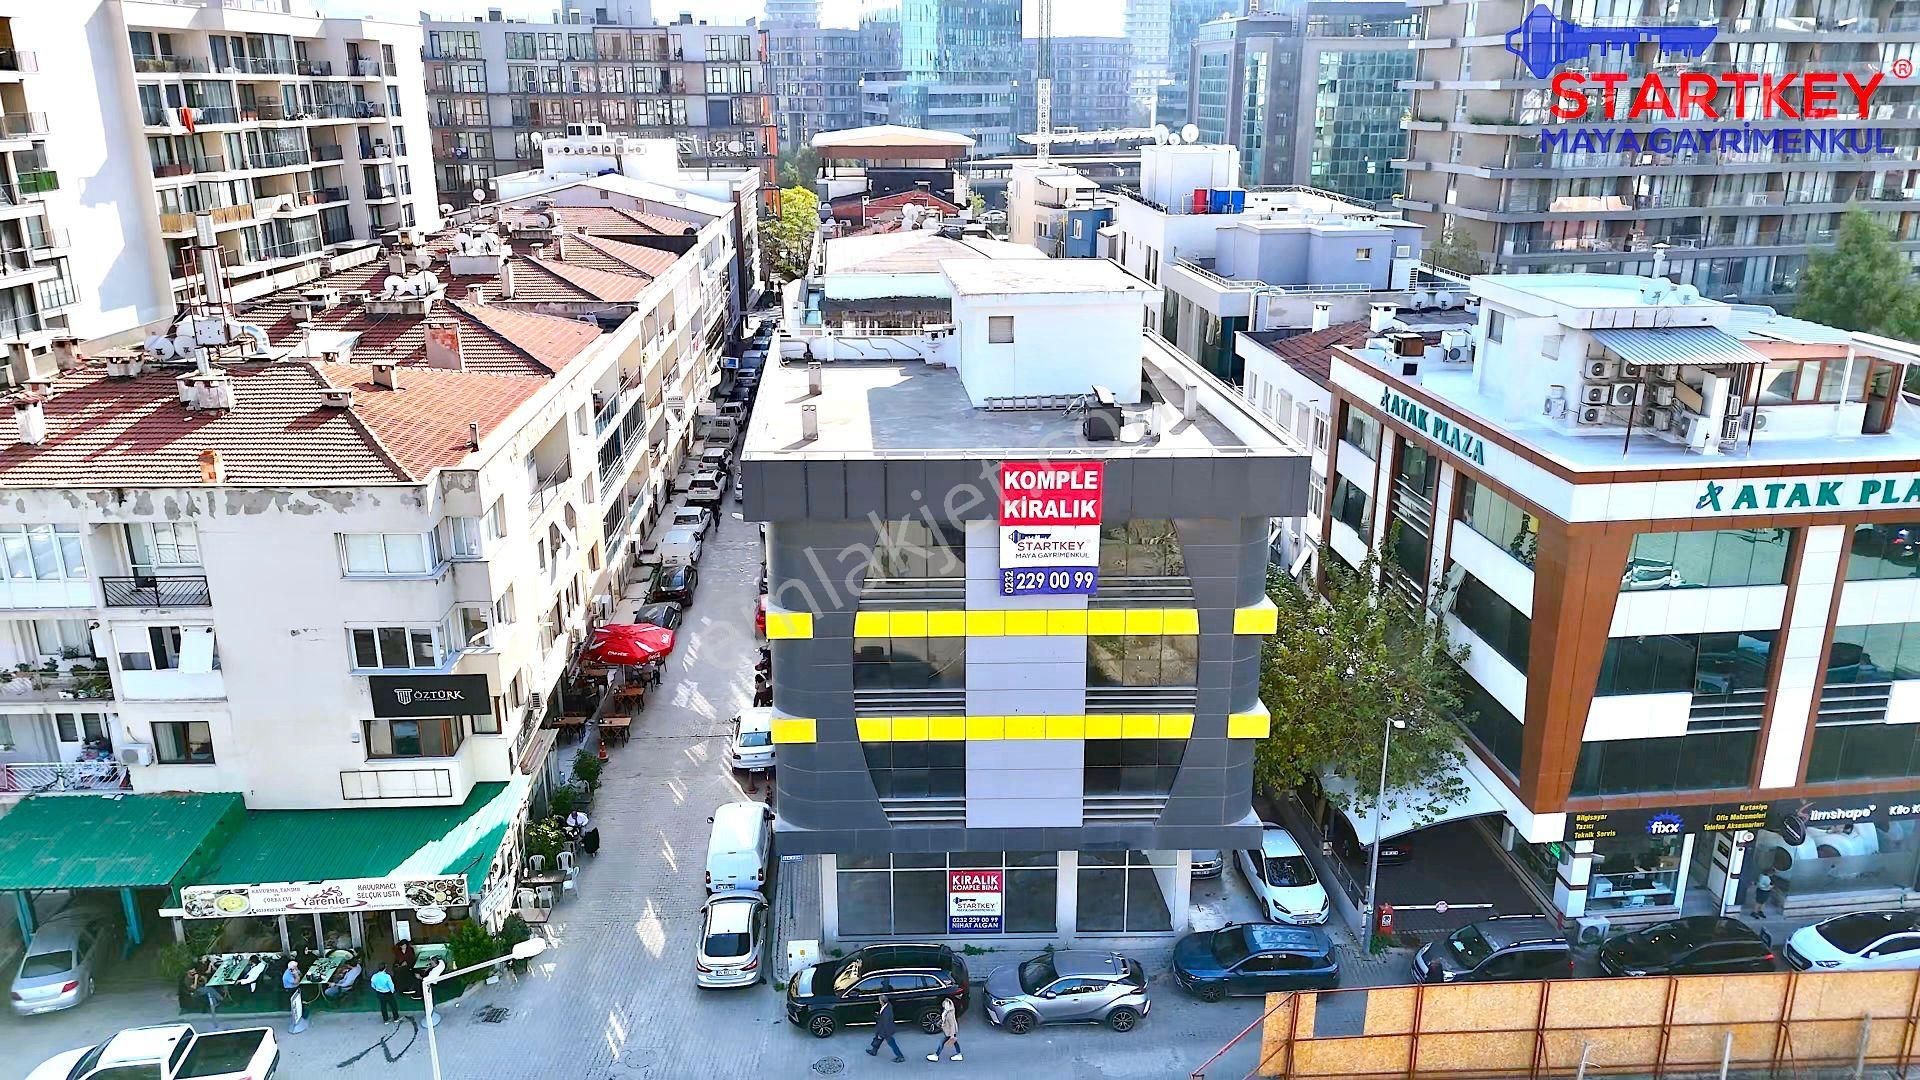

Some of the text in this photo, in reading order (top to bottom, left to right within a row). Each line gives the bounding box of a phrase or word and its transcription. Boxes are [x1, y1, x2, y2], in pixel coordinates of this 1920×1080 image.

[1390, 394, 1484, 466] ATAK PLAZA
[1004, 470, 1098, 490] KOMPLE
[1731, 481, 1843, 510] ATAK
[1004, 496, 1098, 519] KİRALIK
[1017, 541, 1085, 551] STARTKEY
[1004, 570, 1014, 594] 0232
[1016, 571, 1094, 590] 229 00 99
[413, 689, 465, 700] ÖZTÜRK
[1888, 804, 1911, 816] Kilo
[1576, 813, 1608, 822] Bilgisayar
[1651, 820, 1680, 834] fixx
[1574, 829, 1616, 839] Teknik Servis
[383, 890, 401, 898] USTA
[301, 896, 351, 906] Yarenler
